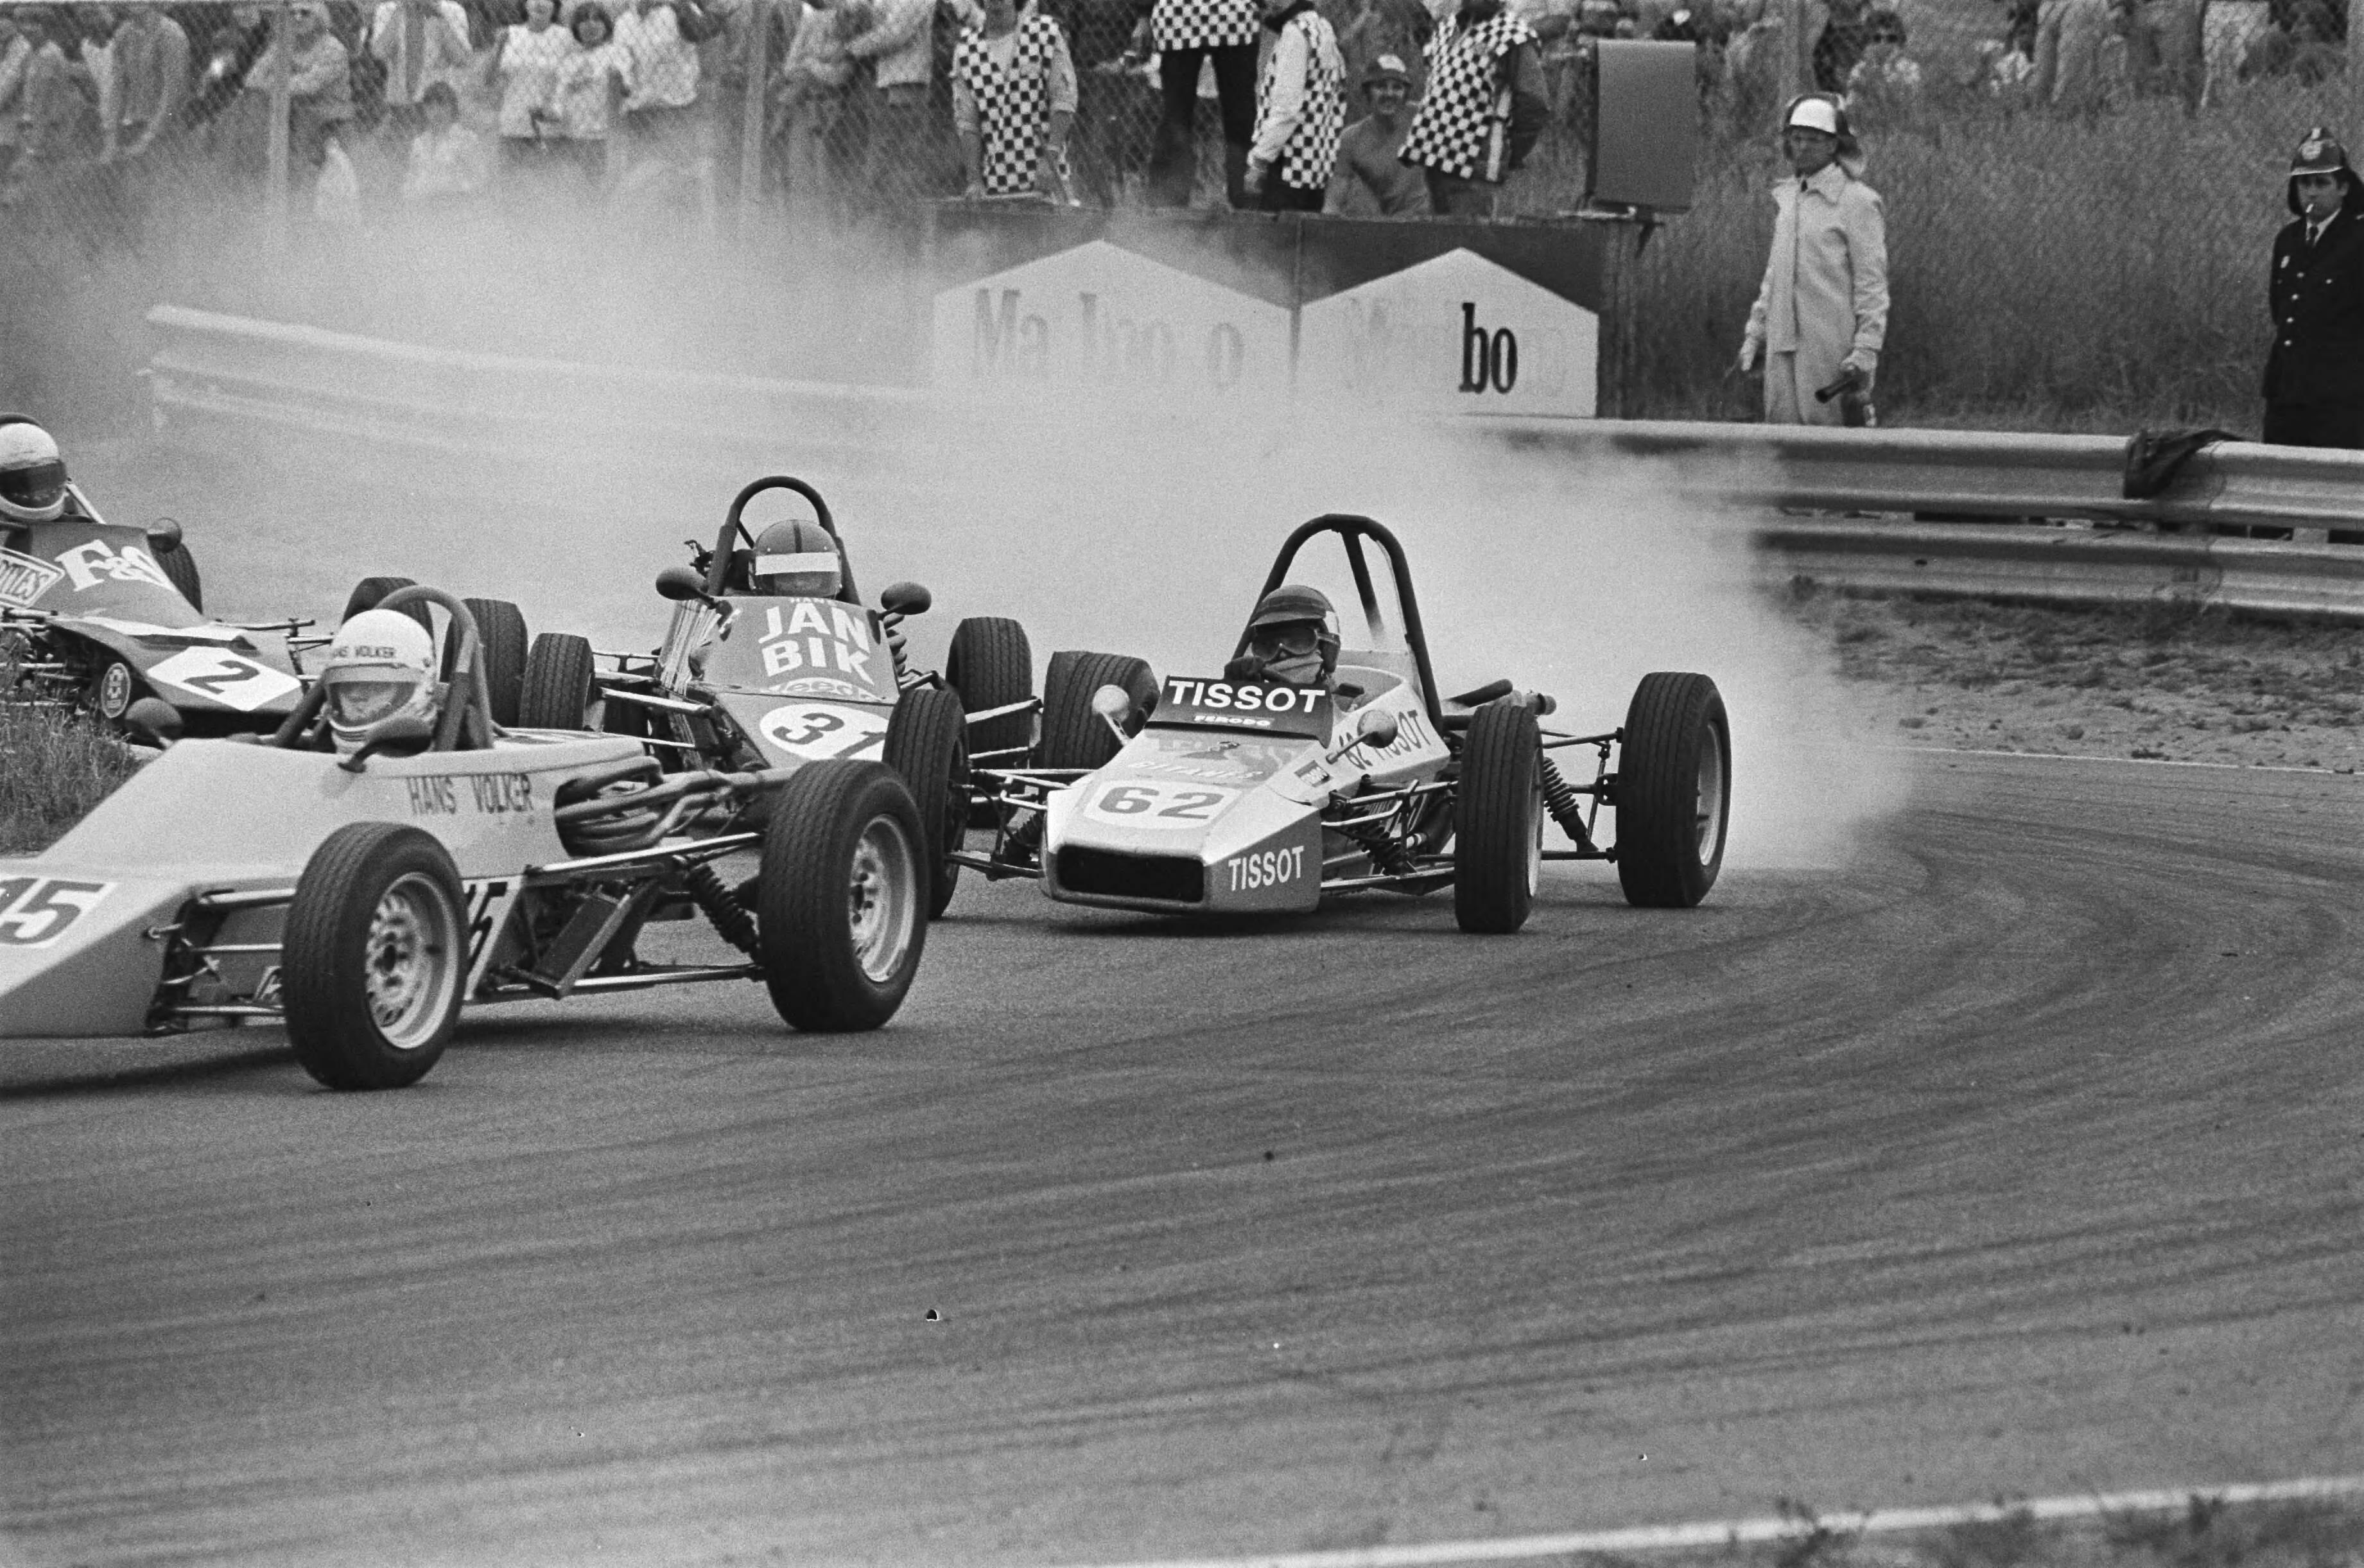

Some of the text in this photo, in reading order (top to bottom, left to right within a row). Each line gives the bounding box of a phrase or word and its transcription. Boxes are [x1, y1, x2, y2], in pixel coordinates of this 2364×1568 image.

[758, 602, 871, 654] JAN
[182, 660, 261, 695] 2
[762, 637, 874, 686] BIK
[1169, 680, 1326, 713] TISSOT
[406, 776, 456, 815] HANS
[1098, 786, 1225, 820] 62
[1228, 845, 1305, 892] TISSOT
